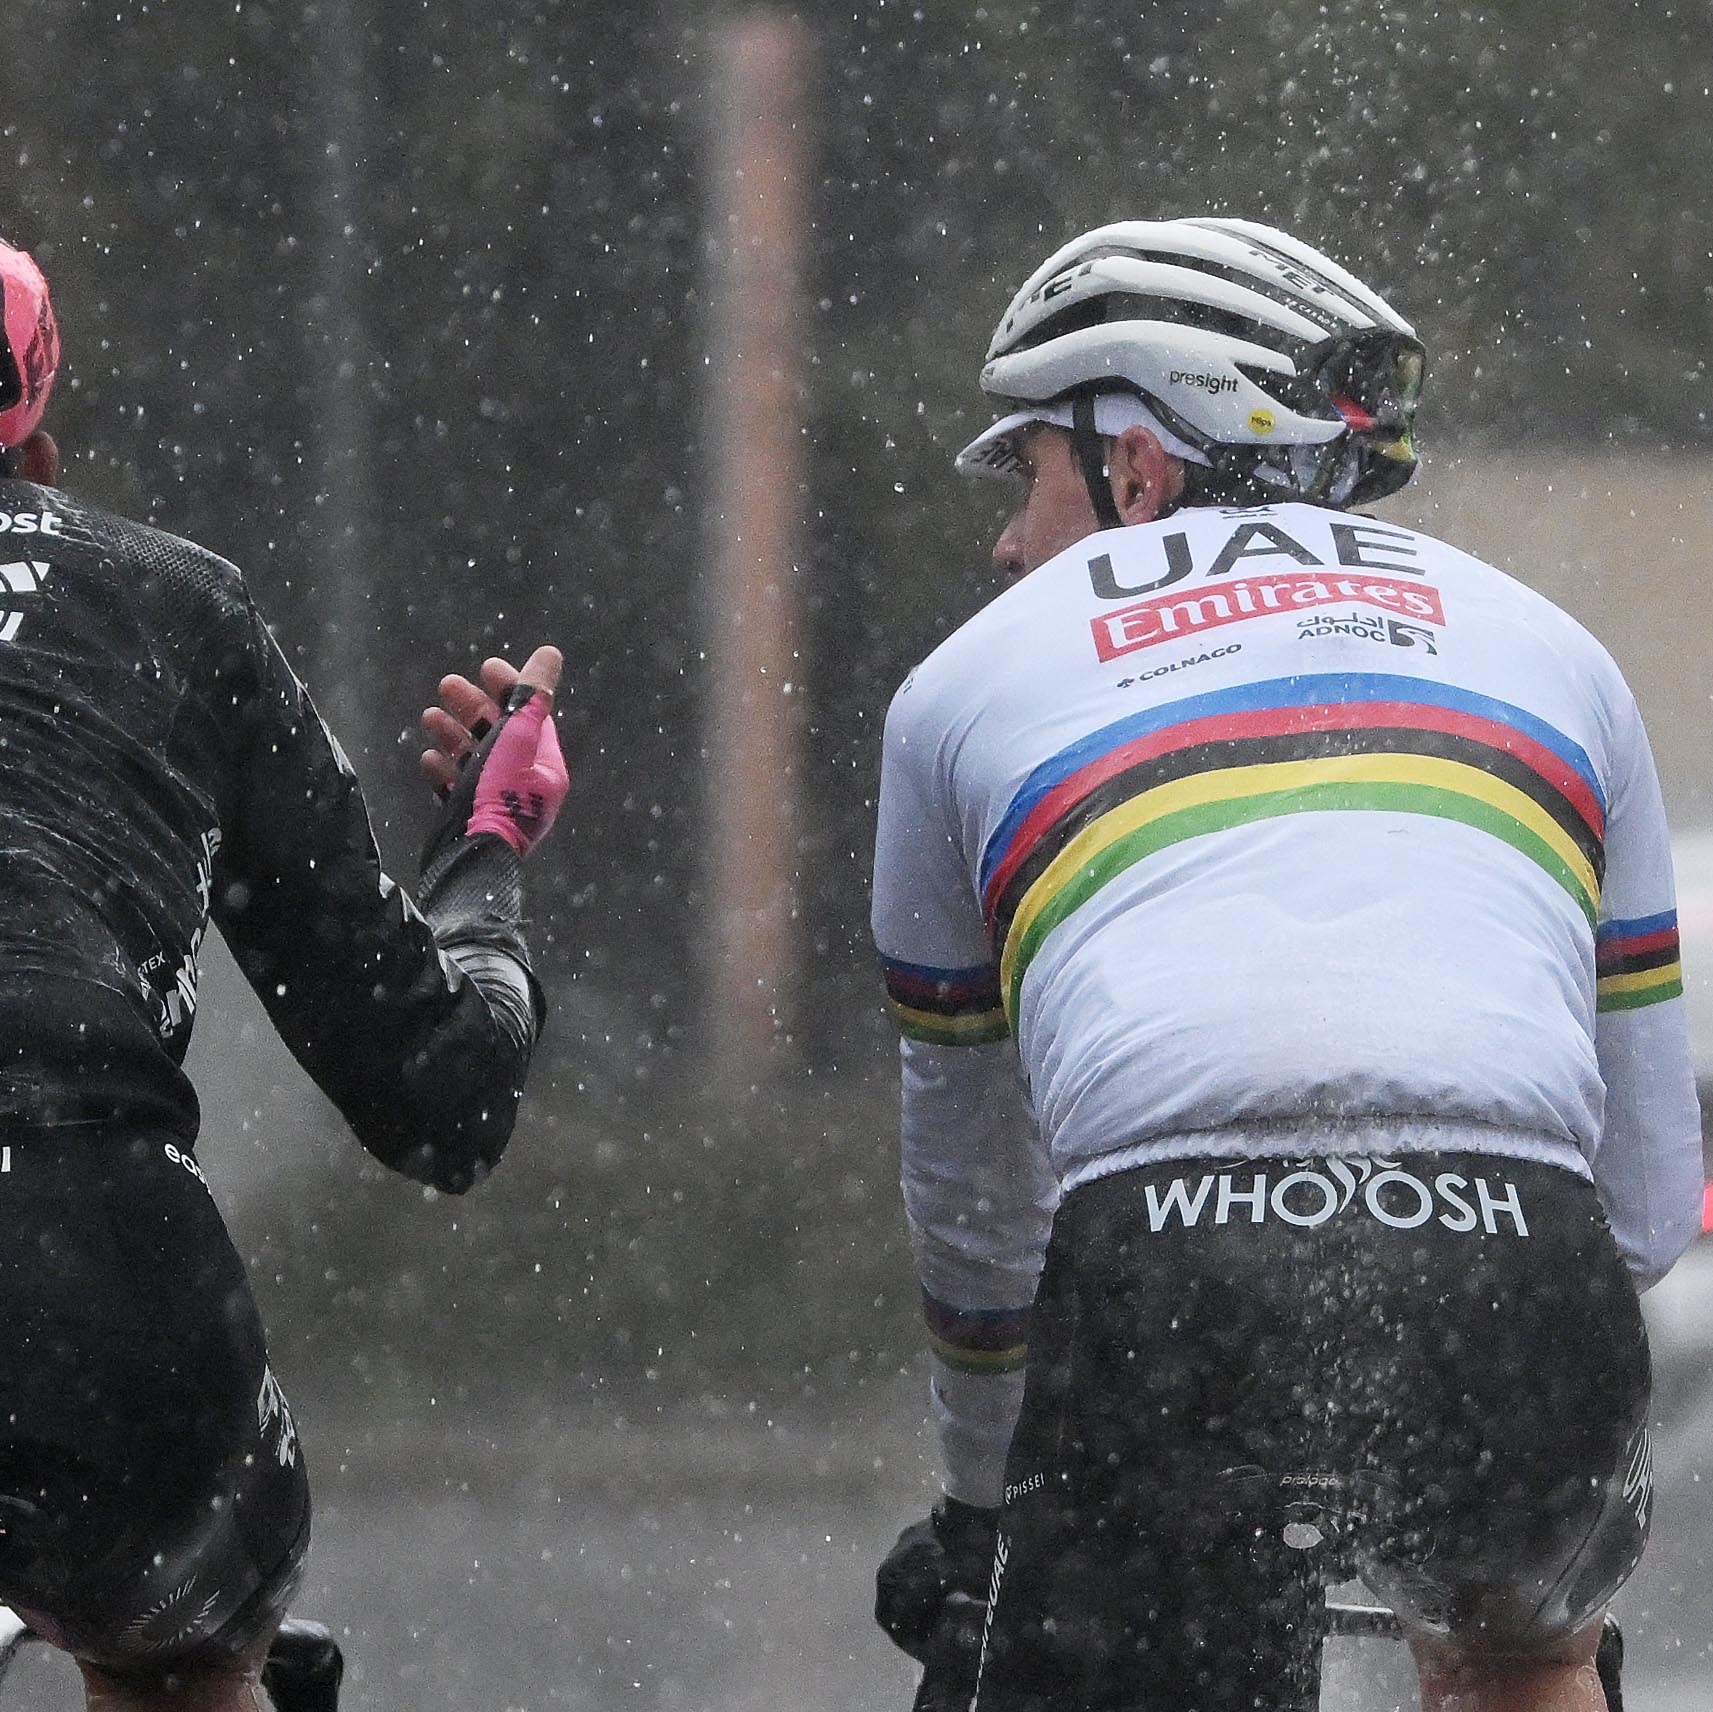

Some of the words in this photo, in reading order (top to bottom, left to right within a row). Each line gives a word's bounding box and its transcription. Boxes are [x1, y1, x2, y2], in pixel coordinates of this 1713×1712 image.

[1169, 370, 1239, 395] presight
[1087, 521, 1427, 601] UAE
[1103, 577, 1435, 649] Emirates
[1297, 624, 1386, 643] ADNOC
[1138, 642, 1243, 683] COLNAGO
[1144, 1170, 1530, 1237] WHOOSH
[1012, 1472, 1045, 1500] PISSEI
